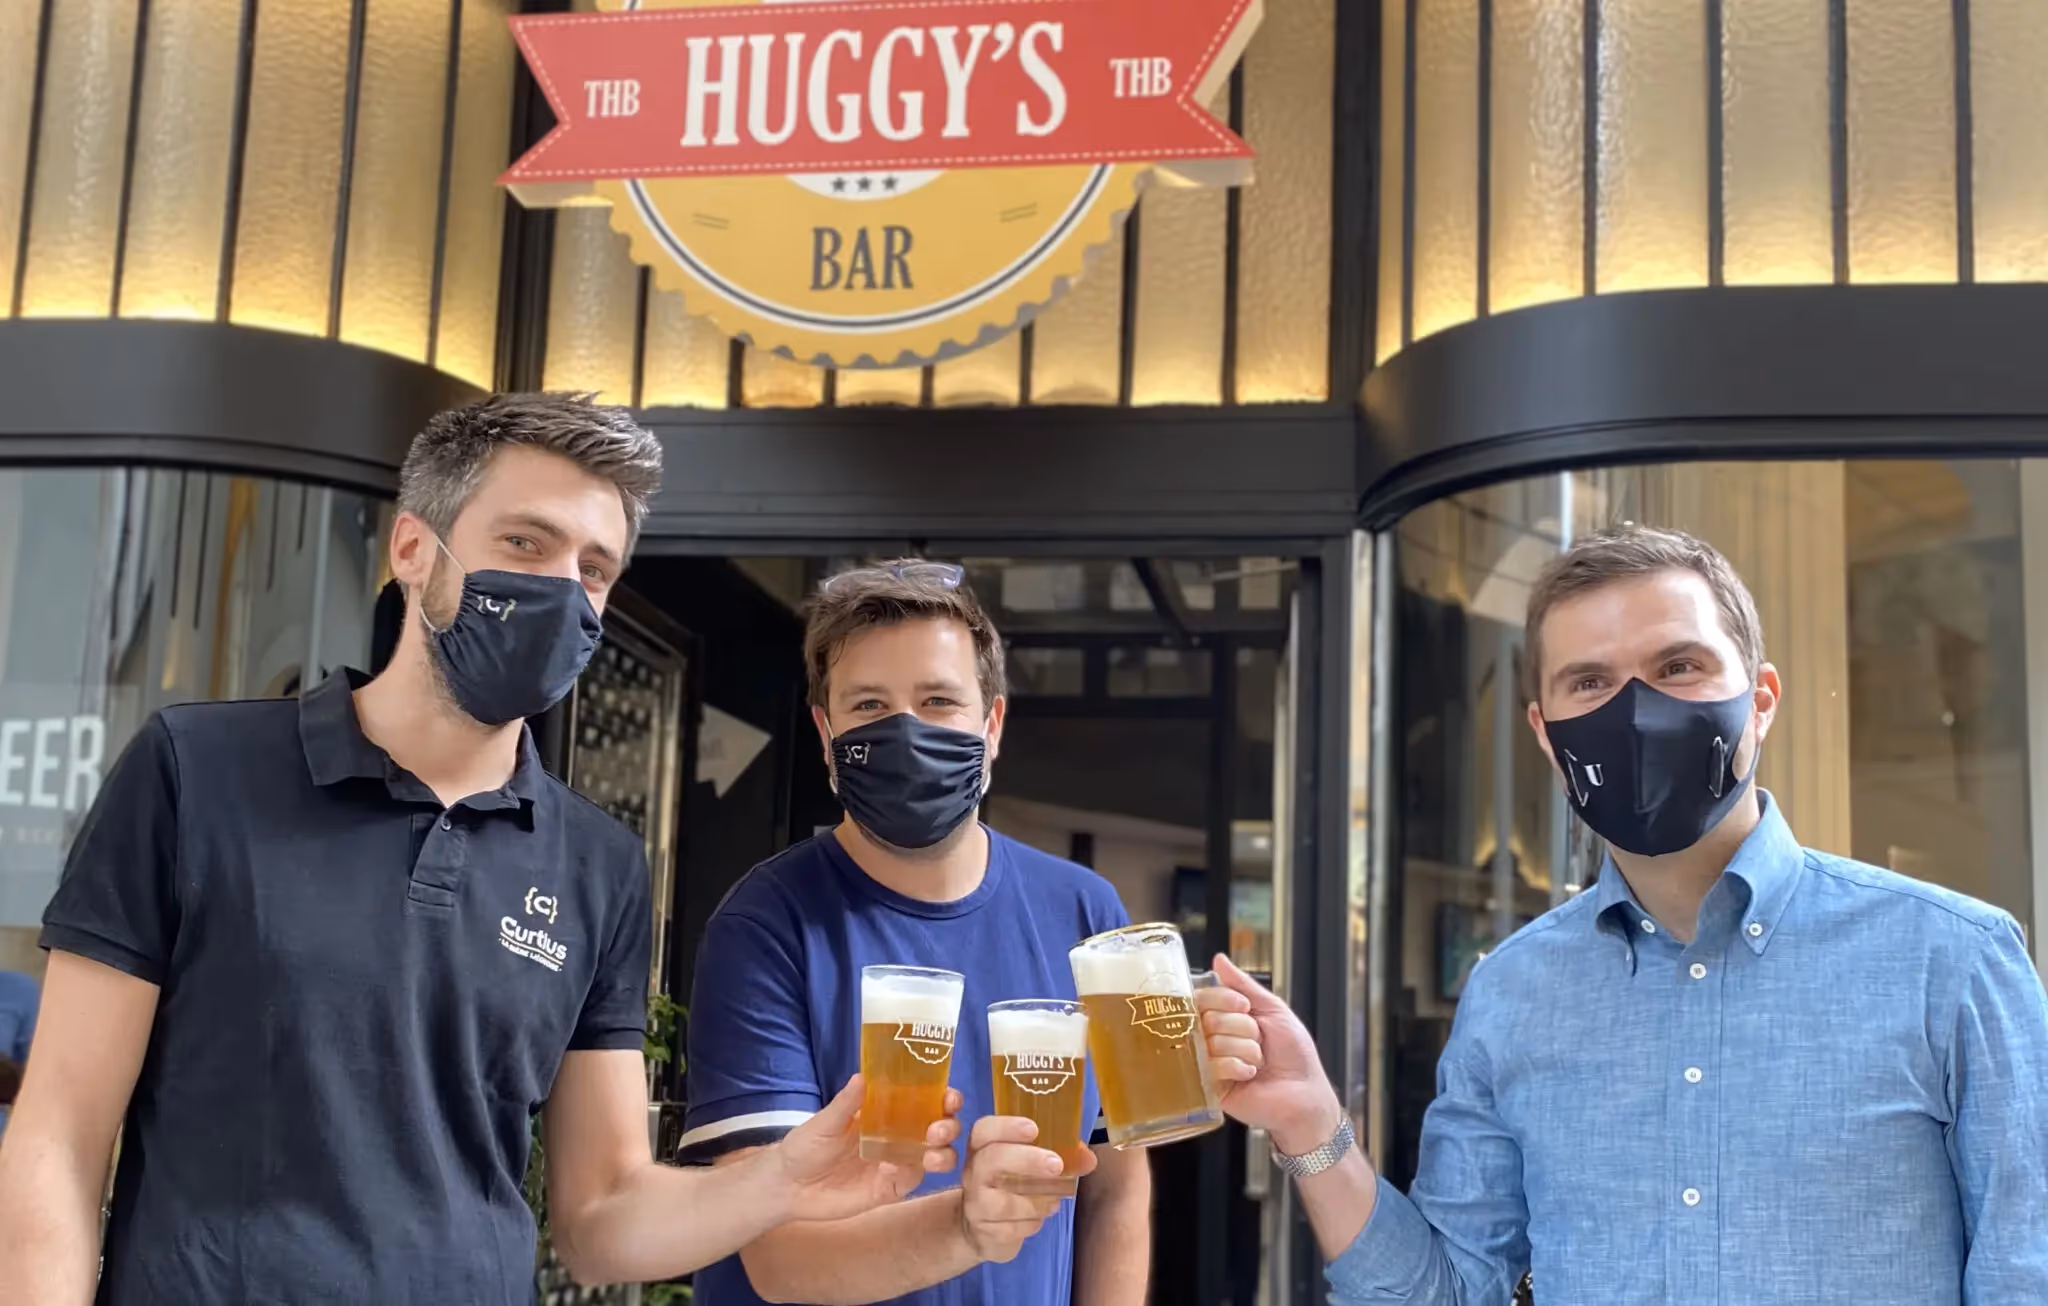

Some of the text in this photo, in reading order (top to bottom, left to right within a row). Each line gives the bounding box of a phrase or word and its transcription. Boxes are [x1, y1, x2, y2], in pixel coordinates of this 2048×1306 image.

[584, 21, 1173, 148] THB HUGGY'S THB
[809, 226, 914, 292] BAR
[500, 915, 568, 961] Curtius
[1143, 996, 1190, 1016] HUGGS
[911, 1021, 953, 1041] HUGGYS
[1016, 1051, 1065, 1069] HUGGYS
